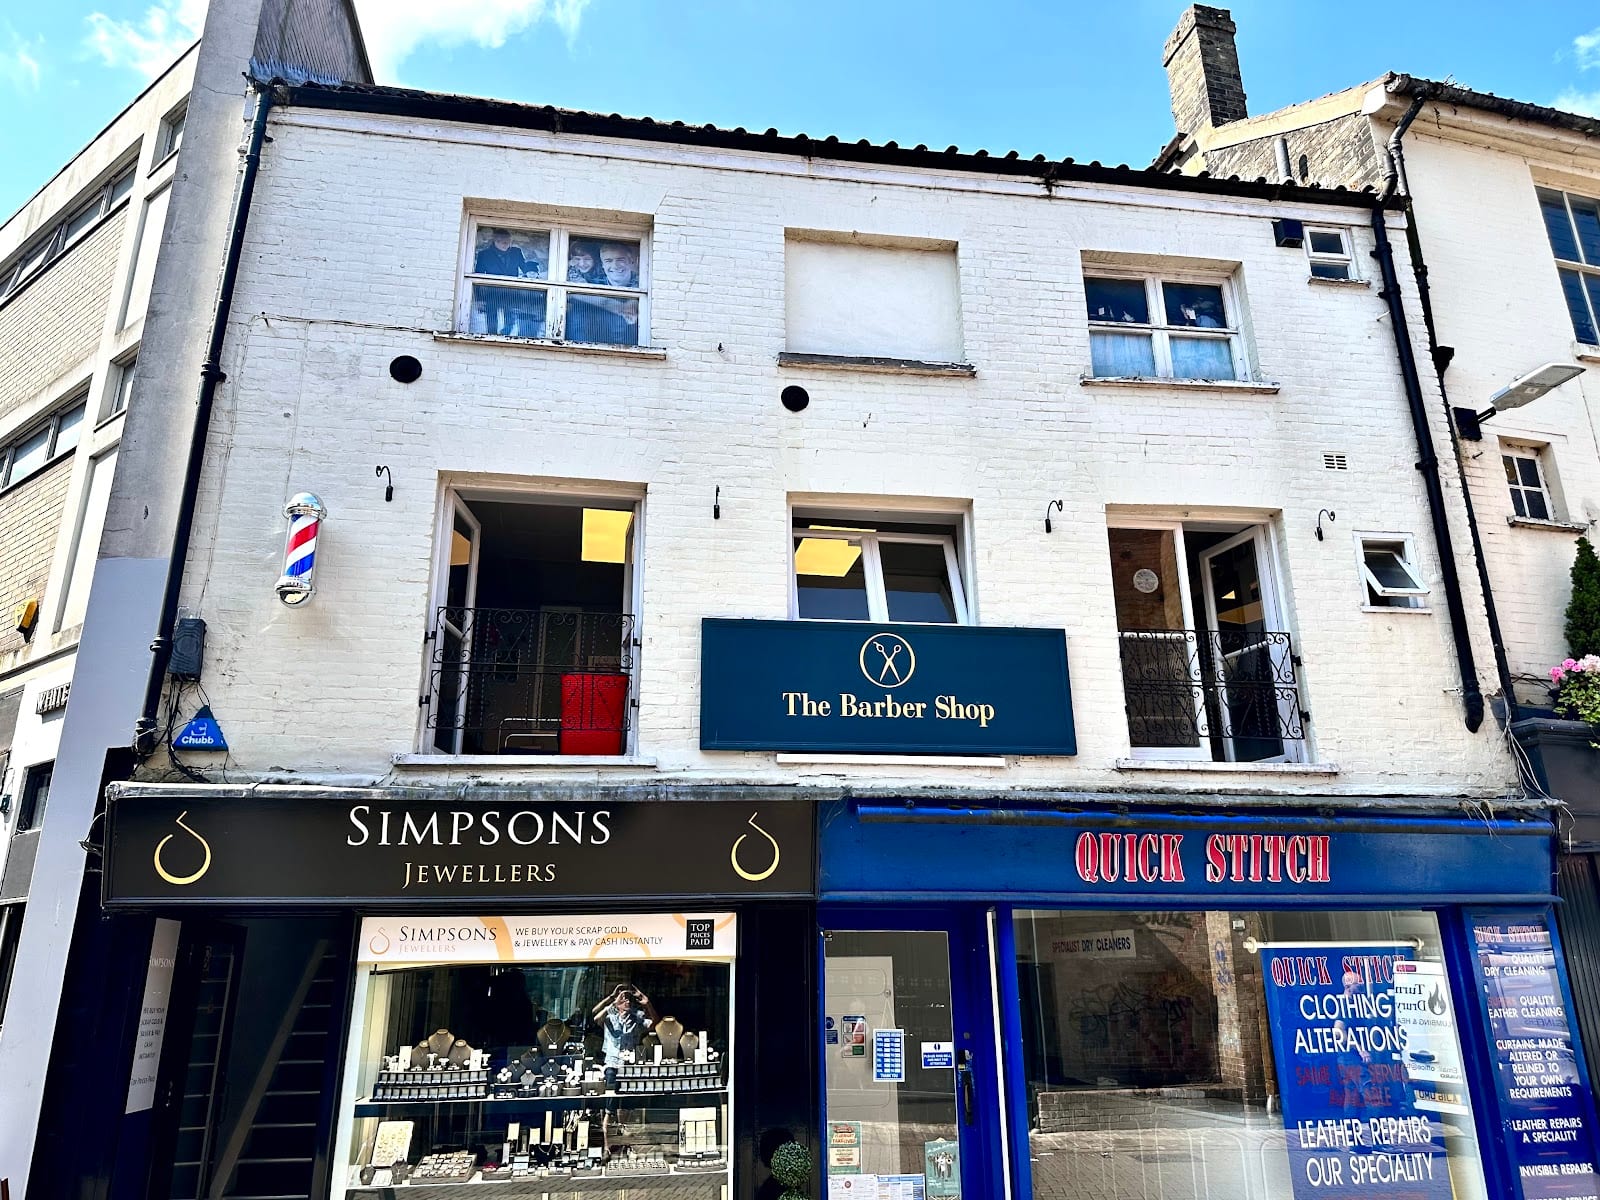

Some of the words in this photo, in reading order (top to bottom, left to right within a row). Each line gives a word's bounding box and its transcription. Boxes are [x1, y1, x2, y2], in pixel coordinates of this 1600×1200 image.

[783, 692, 832, 717] The
[840, 694, 927, 719] Barber
[935, 695, 995, 728] Shop
[182, 736, 214, 745] Chubb
[347, 805, 611, 846] SIMPSONS
[1075, 832, 1185, 883] QUICK
[1206, 833, 1331, 883] STITCH
[402, 862, 556, 889] JEWELLERS
[399, 926, 498, 942] SIMPSONS
[515, 928, 530, 936] WE
[531, 927, 549, 935] BUY
[550, 927, 574, 935] YOUR
[576, 926, 603, 934] SCRAP
[605, 926, 628, 934] GOLD
[690, 923, 711, 932] TOP
[1474, 926, 1502, 943] UICK
[400, 943, 456, 953] JEWELLERS
[523, 938, 569, 947] JEWELLERY
[578, 938, 594, 946] PAY
[595, 937, 618, 945] CASH
[619, 936, 663, 945] INSTANTLY
[690, 938, 711, 946] PAID
[1051, 940, 1080, 954] SPECIALIST
[1081, 939, 1094, 951] DRY
[1096, 936, 1131, 951] CLEANERS
[149, 957, 176, 968] IMPSONS
[1511, 954, 1546, 965] QUALITY
[1271, 957, 1332, 987] QUICK
[1484, 966, 1500, 977] DRY
[1503, 965, 1546, 977] CLEANING
[1519, 995, 1555, 1006] QUALITY
[1300, 994, 1392, 1021] CLOTHING
[1488, 1007, 1519, 1019] EATHER
[1521, 1006, 1563, 1018] CLEANING
[1295, 1025, 1410, 1054] ALTERATIONS
[1496, 1039, 1536, 1051] CURTAINS
[1509, 1050, 1544, 1062] ALTERED
[1546, 1050, 1558, 1061] OR
[1512, 1062, 1547, 1074] RELINED
[1549, 1062, 1560, 1073] TO
[1514, 1075, 1540, 1086] YOUR
[1541, 1074, 1563, 1086] OWN
[1510, 1086, 1572, 1099] REQUIREMENTS
[1512, 1119, 1547, 1131] LEATHER
[1549, 1117, 1583, 1129] REPAIRS
[1297, 1118, 1362, 1149] LEATHER
[1371, 1115, 1432, 1146] REPAIRS
[1523, 1132, 1531, 1143] A
[1532, 1130, 1577, 1143] SPECIALITY
[1306, 1158, 1343, 1187] OUR
[1350, 1152, 1433, 1185] SPECIALITY
[1519, 1165, 1559, 1177] INVISIBLE
[1560, 1163, 1594, 1175] REPAIRS
